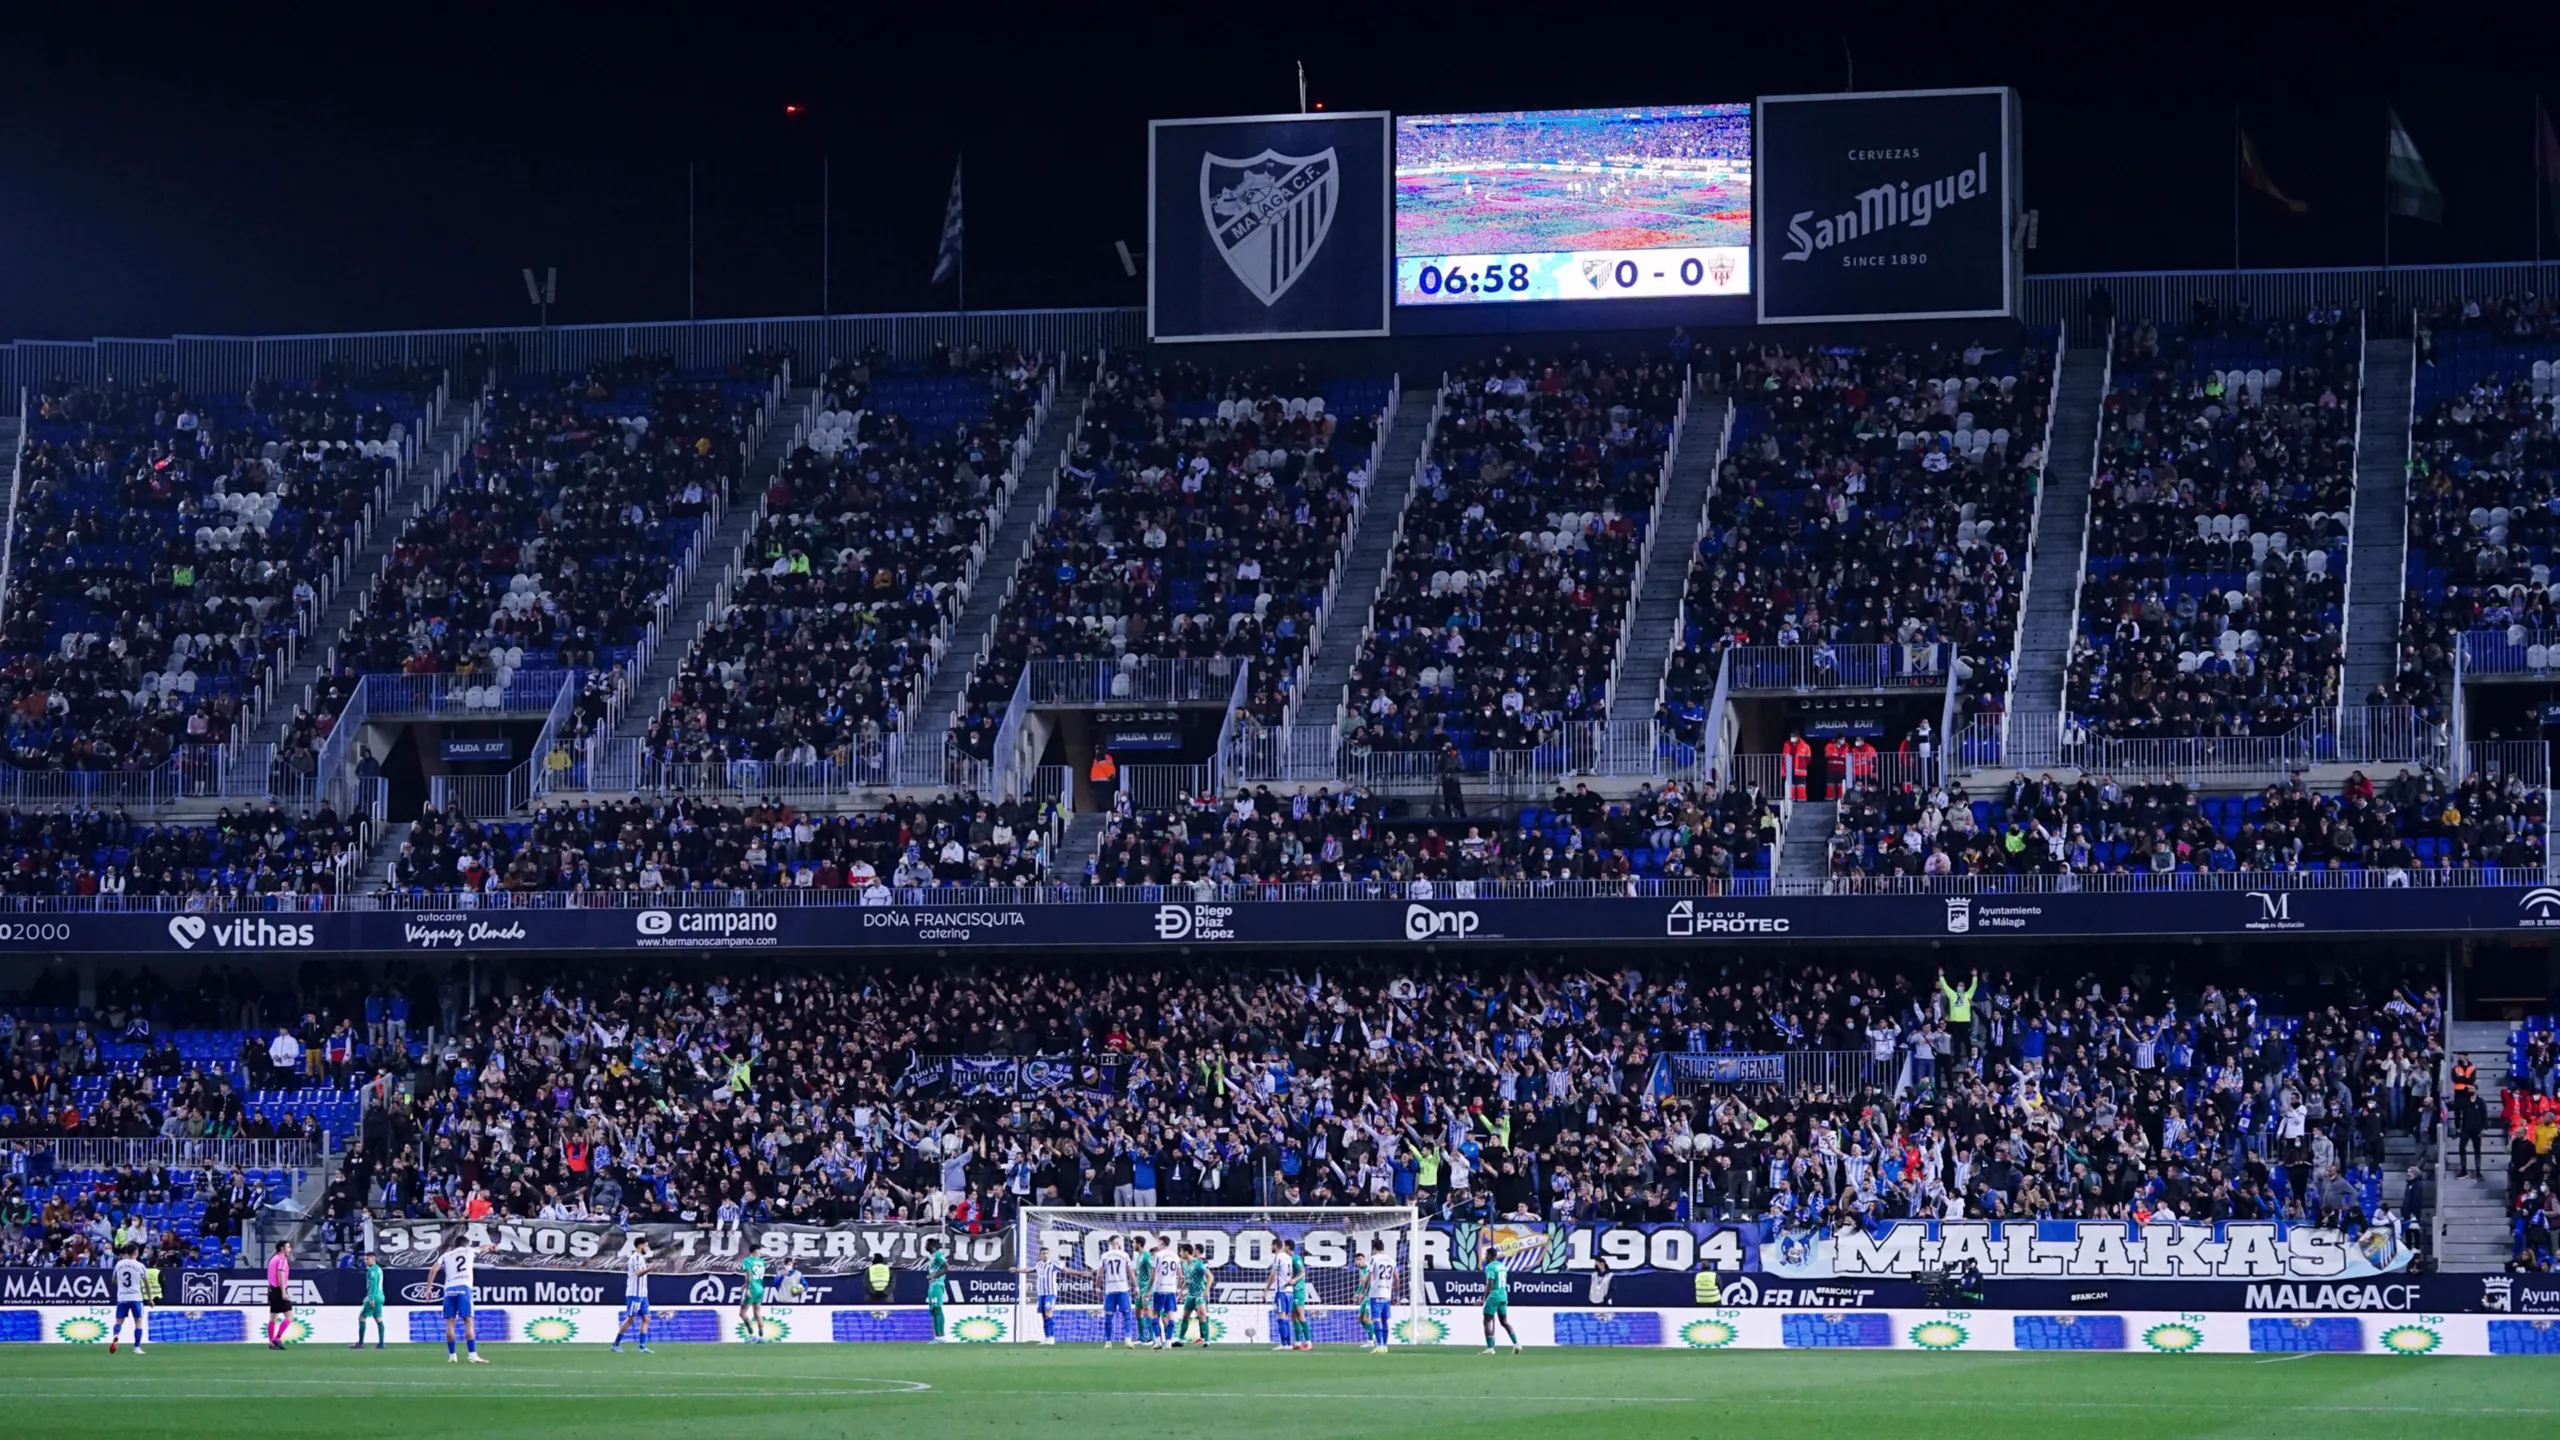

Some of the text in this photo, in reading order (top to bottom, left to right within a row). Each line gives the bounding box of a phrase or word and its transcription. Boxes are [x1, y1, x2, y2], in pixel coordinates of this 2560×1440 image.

[1848, 148, 1920, 160] CERVEZAS
[1843, 253, 1927, 267] SINCE 1890
[1419, 263, 1529, 294] 06:58
[1615, 259, 1638, 288] 0
[1680, 257, 1704, 286] 0
[1815, 719, 1874, 729] SALIDA EXIT
[1116, 732, 1172, 741] SALIDA EXIT
[449, 743, 504, 752] SALIDA EXIT
[416, 913, 467, 921] autocares
[1195, 905, 1233, 918] Diego
[1978, 906, 2042, 916] Ayuntamiento
[679, 910, 777, 934] campano
[863, 910, 1025, 928] DOÑA FRANCISQUITA
[1195, 916, 1224, 927] Díaz
[1978, 917, 2026, 928] de Málaga
[468, 921, 526, 941] Olmedo
[1697, 919, 1790, 932] PROTEC
[212, 918, 314, 947] vithas
[919, 926, 970, 941] catering
[1195, 928, 1234, 940] López
[636, 937, 777, 947] www.hermanoscampano.com
[1739, 1055, 1784, 1079] GENAL
[379, 1225, 443, 1254] 35
[673, 1230, 742, 1257] TU
[1567, 1228, 1743, 1271] 1904
[1833, 1222, 2346, 1277] MALAKAS
[455, 1255, 467, 1273] 2
[1108, 1259, 1121, 1275] 17
[1161, 1260, 1177, 1276] 39
[1379, 1264, 1392, 1280] 23
[4, 1271, 110, 1298] MÁLAGA
[122, 1271, 131, 1288] 3
[471, 1285, 526, 1303] arum
[534, 1282, 604, 1303] Motor
[970, 1280, 1033, 1294] Diputacn
[1513, 1281, 1573, 1293] Provincial
[89, 1306, 111, 1315] bp
[294, 1306, 316, 1315] bp
[558, 1305, 580, 1315] bp
[771, 1306, 792, 1315] bp
[986, 1305, 1009, 1314] bp
[1428, 1306, 1452, 1316] bp
[1716, 1308, 1741, 1318] bp
[1947, 1310, 1971, 1320] bp
[2181, 1312, 2206, 1322] bp
[2419, 1314, 2444, 1324] bp
